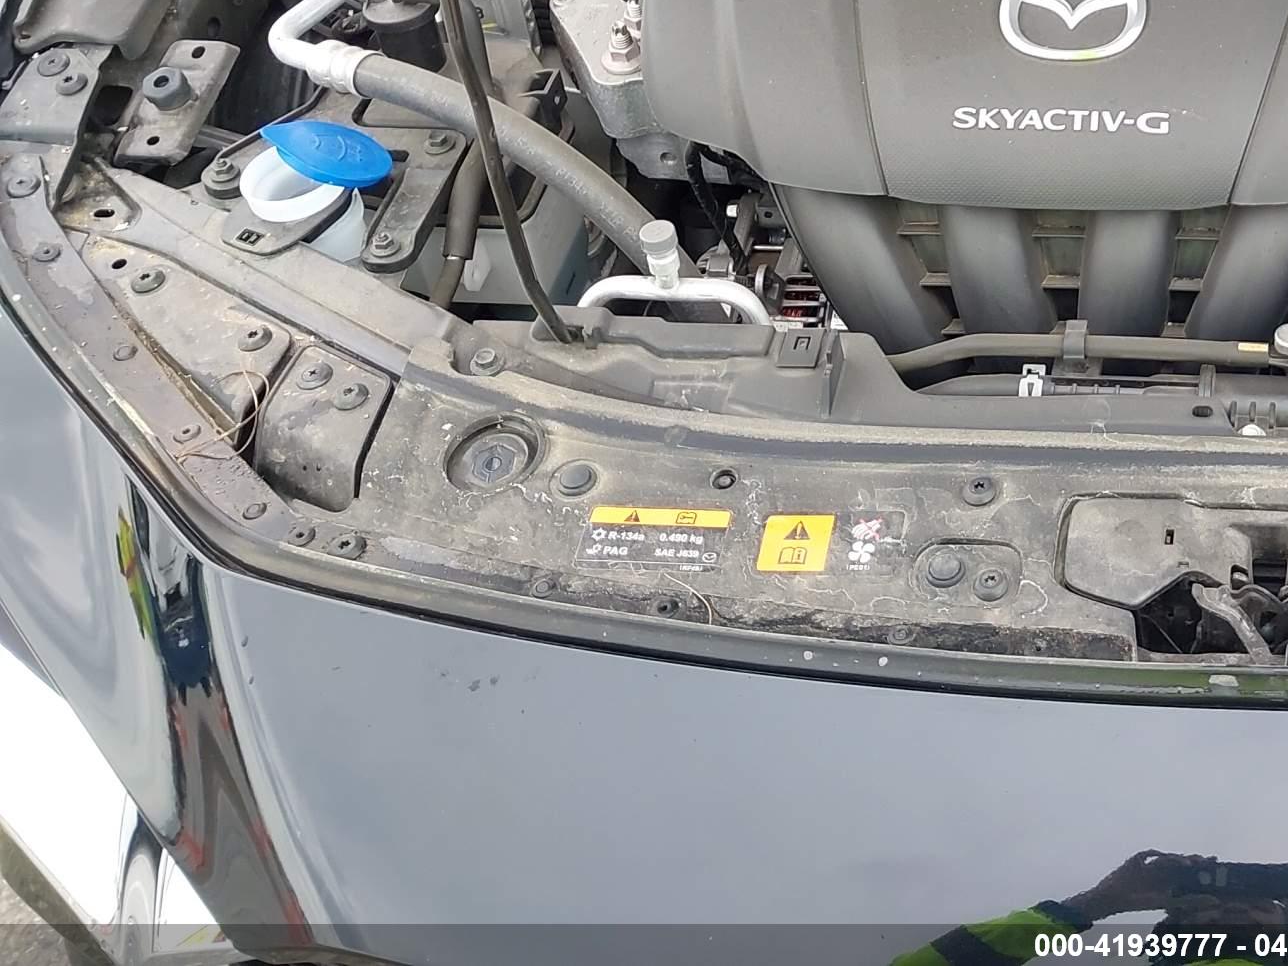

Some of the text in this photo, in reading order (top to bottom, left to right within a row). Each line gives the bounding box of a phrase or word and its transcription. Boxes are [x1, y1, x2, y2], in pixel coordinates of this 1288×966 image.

[952, 106, 1170, 135] SKYACTIV-G
[607, 530, 645, 542] R-134a
[689, 533, 704, 545] kg
[602, 545, 629, 556] PAG
[654, 547, 675, 558] SAE
